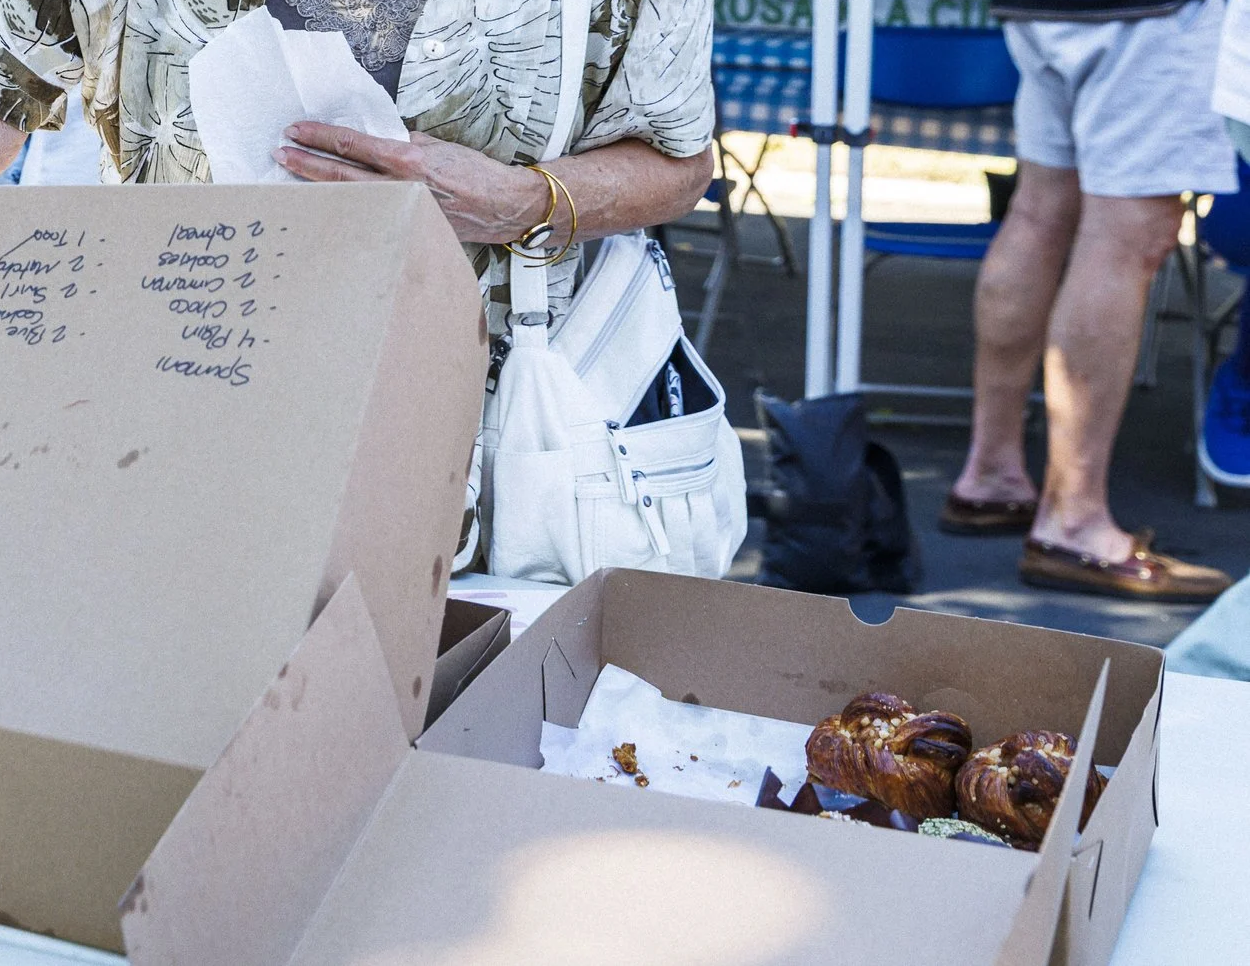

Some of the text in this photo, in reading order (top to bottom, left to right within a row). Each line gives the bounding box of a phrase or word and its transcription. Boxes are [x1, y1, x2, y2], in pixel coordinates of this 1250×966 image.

[247, 220, 264, 237] 2
[78, 231, 85, 247] 1
[69, 255, 84, 272] 2
[243, 247, 258, 264] 2
[233, 272, 255, 289] 2
[1, 283, 77, 304] 2 Swirl
[169, 299, 257, 319] 2 Choco
[6, 325, 66, 345] 2 Blue
[182, 325, 255, 350] 4 Plain
